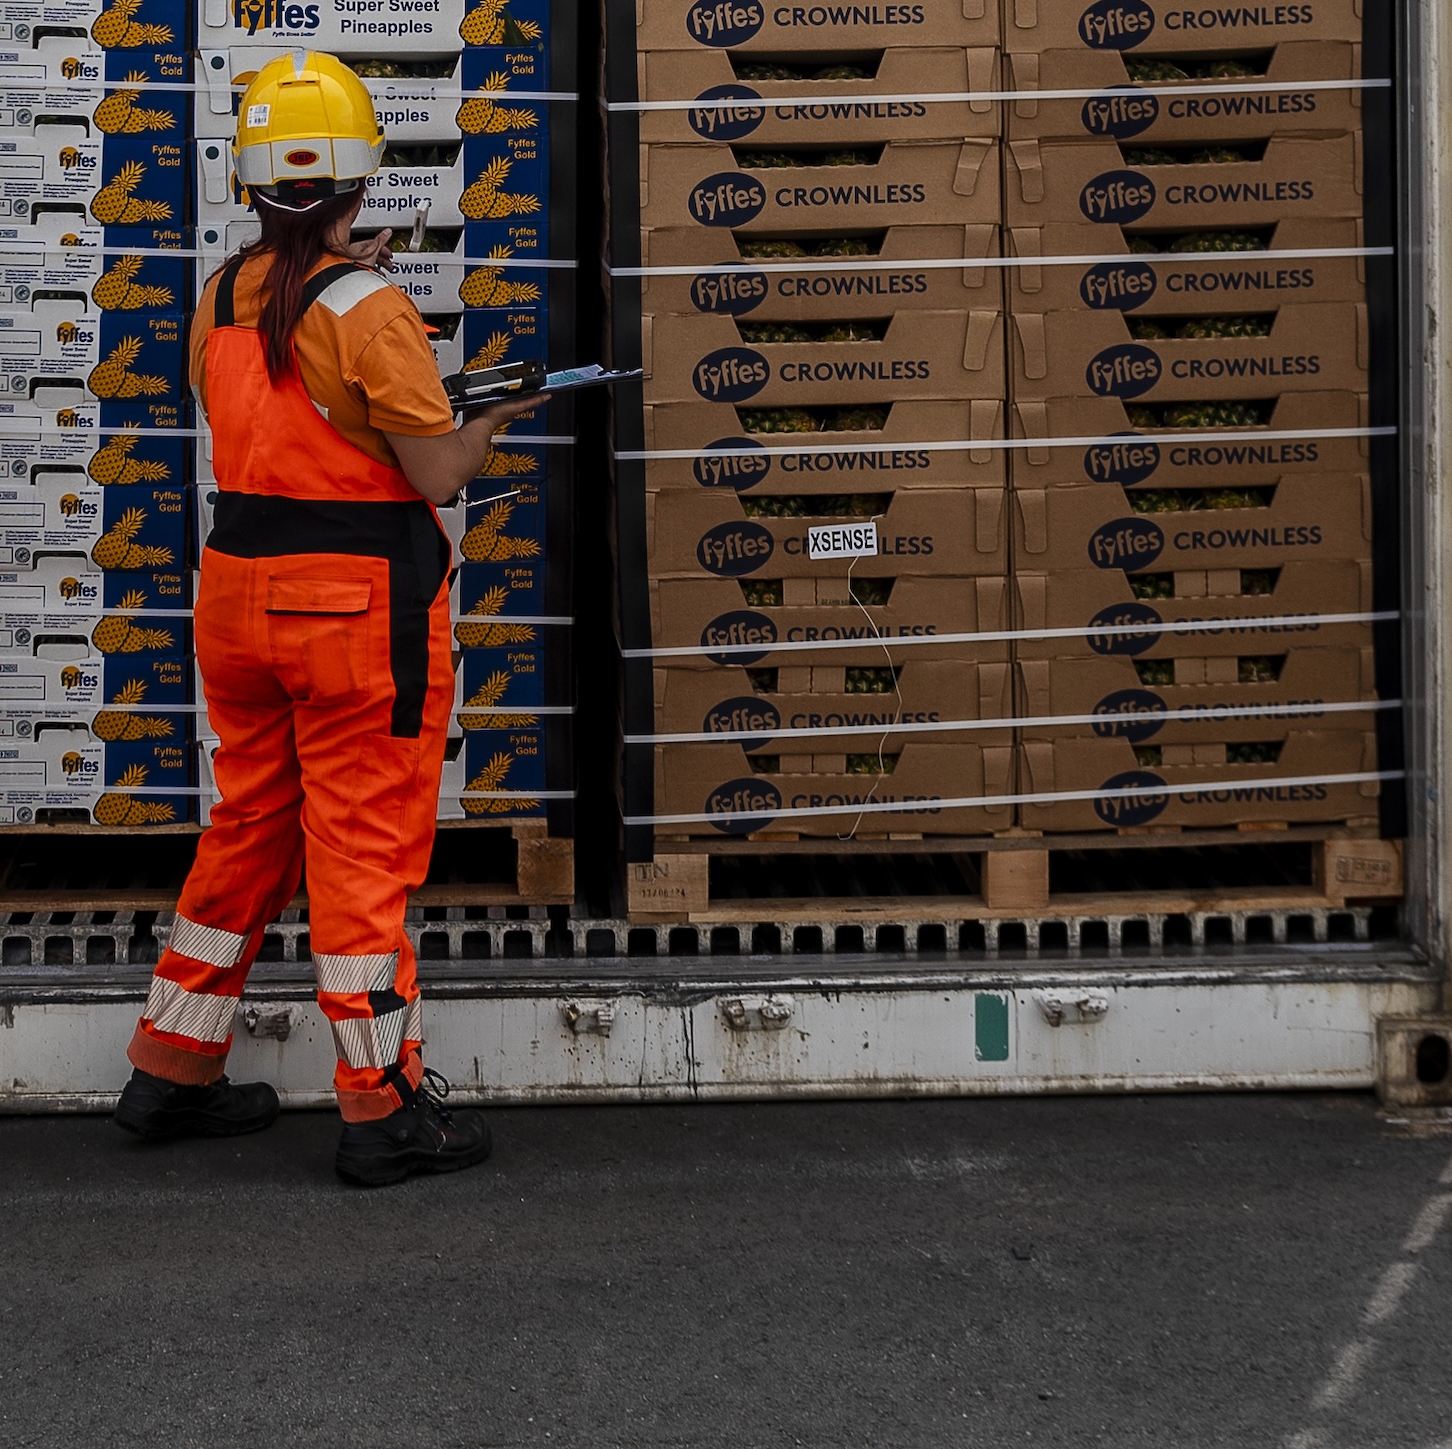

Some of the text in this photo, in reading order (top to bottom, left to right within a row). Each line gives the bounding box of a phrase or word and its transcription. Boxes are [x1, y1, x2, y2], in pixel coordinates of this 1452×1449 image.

[774, 5, 924, 26] CROWNLESS
[1164, 5, 1313, 30] CROWNLESS
[340, 20, 433, 36] Pineapples
[154, 55, 183, 64] Fyffes
[505, 55, 533, 64] Fyffes
[161, 67, 183, 76] Gold
[512, 65, 534, 74] Gold
[1168, 93, 1316, 118] CROWNLESS
[775, 102, 926, 120] CROWNLESS
[508, 139, 536, 149] Fyffes
[152, 146, 180, 155] Fyffes
[514, 150, 536, 160] Gold
[158, 158, 180, 167] Gold
[775, 184, 925, 207] CROWNLESS
[1165, 181, 1313, 204] CROWNLESS
[508, 228, 536, 238] Fyffes
[515, 239, 537, 248] Gold
[778, 274, 927, 297] CROWNLESS
[1166, 269, 1314, 292] CROWNLESS
[508, 315, 535, 324] Fyffes
[149, 320, 177, 330] Fyffes
[514, 326, 535, 334] Gold
[155, 332, 177, 341] Gold
[780, 360, 929, 382] CROWNLESS
[1171, 355, 1320, 378] CROWNLESS
[149, 406, 177, 415] Fyffes
[155, 418, 177, 426] Gold
[1169, 443, 1318, 466] CROWNLESS
[780, 450, 930, 472] CROWNLESS
[153, 492, 181, 501] Fyffes
[159, 504, 181, 512] Gold
[810, 528, 874, 553] XSENSE
[1173, 526, 1322, 550] CROWNLESS
[153, 663, 181, 672] Fyffes
[160, 675, 181, 683] Gold
